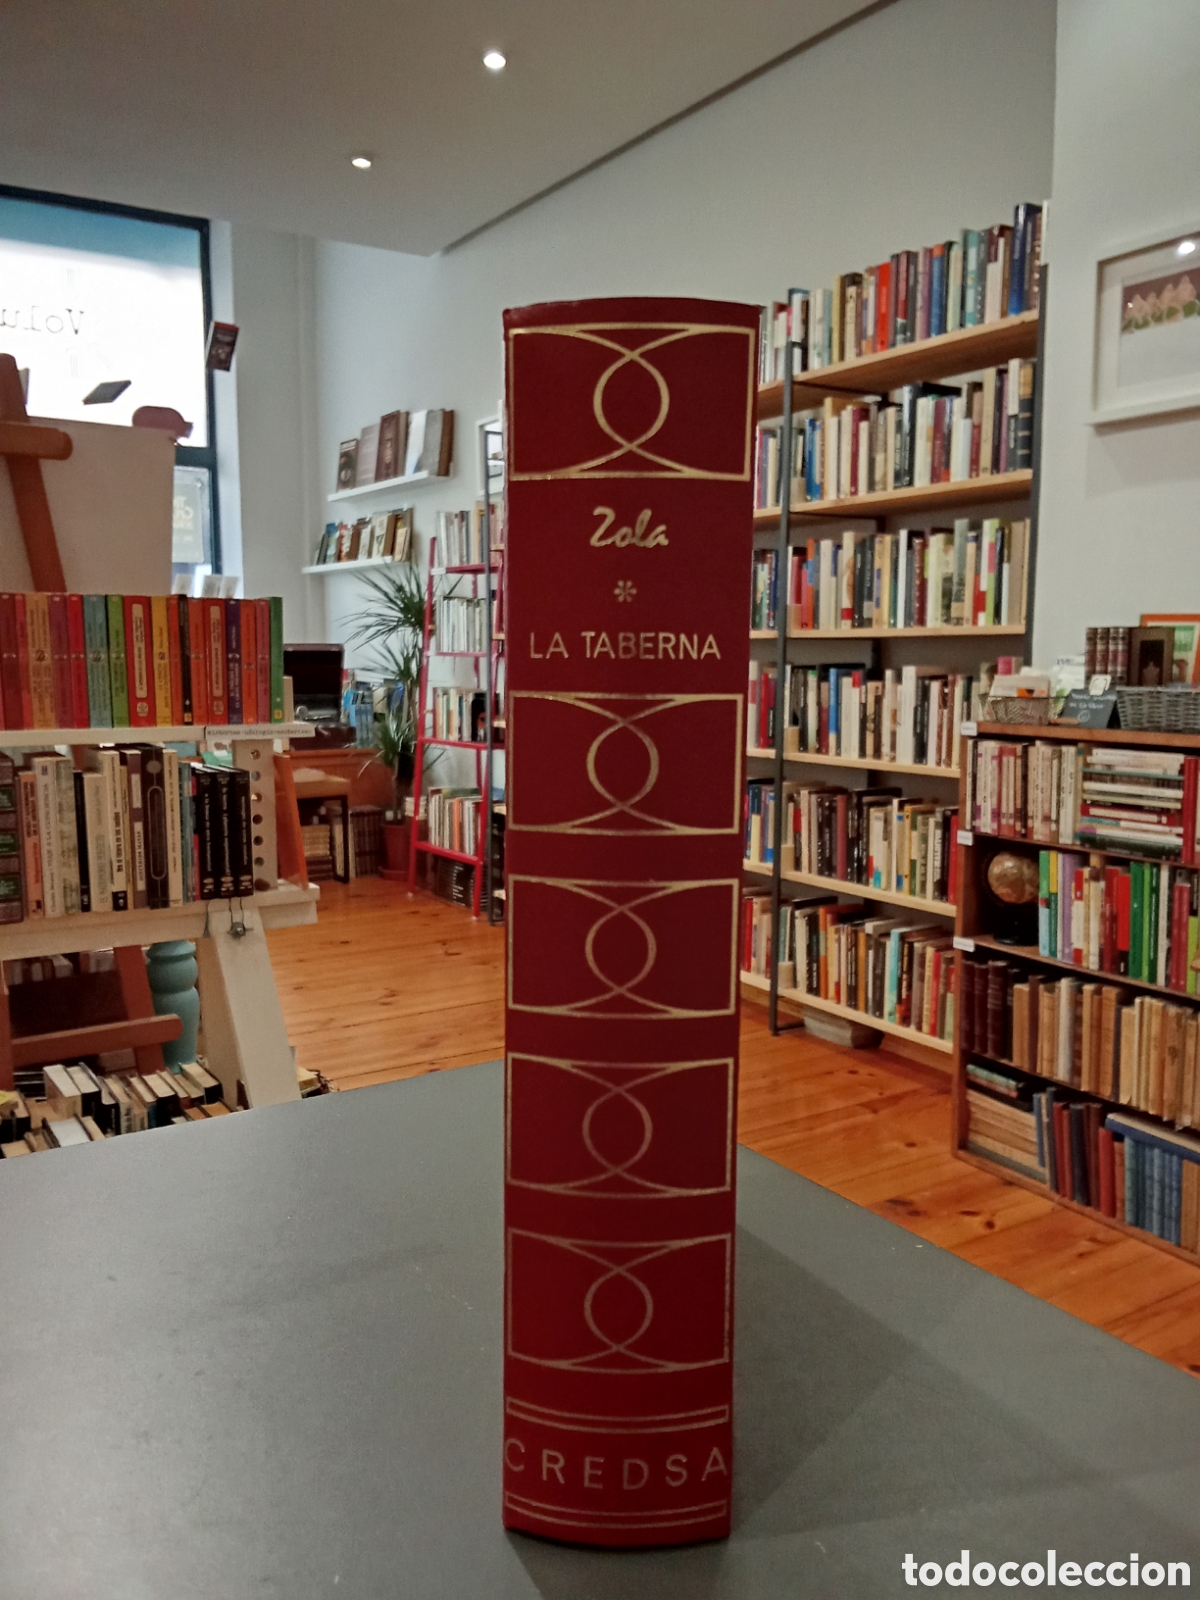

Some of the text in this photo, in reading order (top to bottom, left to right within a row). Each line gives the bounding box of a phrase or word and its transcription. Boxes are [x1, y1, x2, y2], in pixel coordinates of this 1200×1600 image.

[589, 506, 670, 549] Zola
[529, 631, 722, 660] LA TABERNA
[504, 1438, 728, 1490] CREDSA
